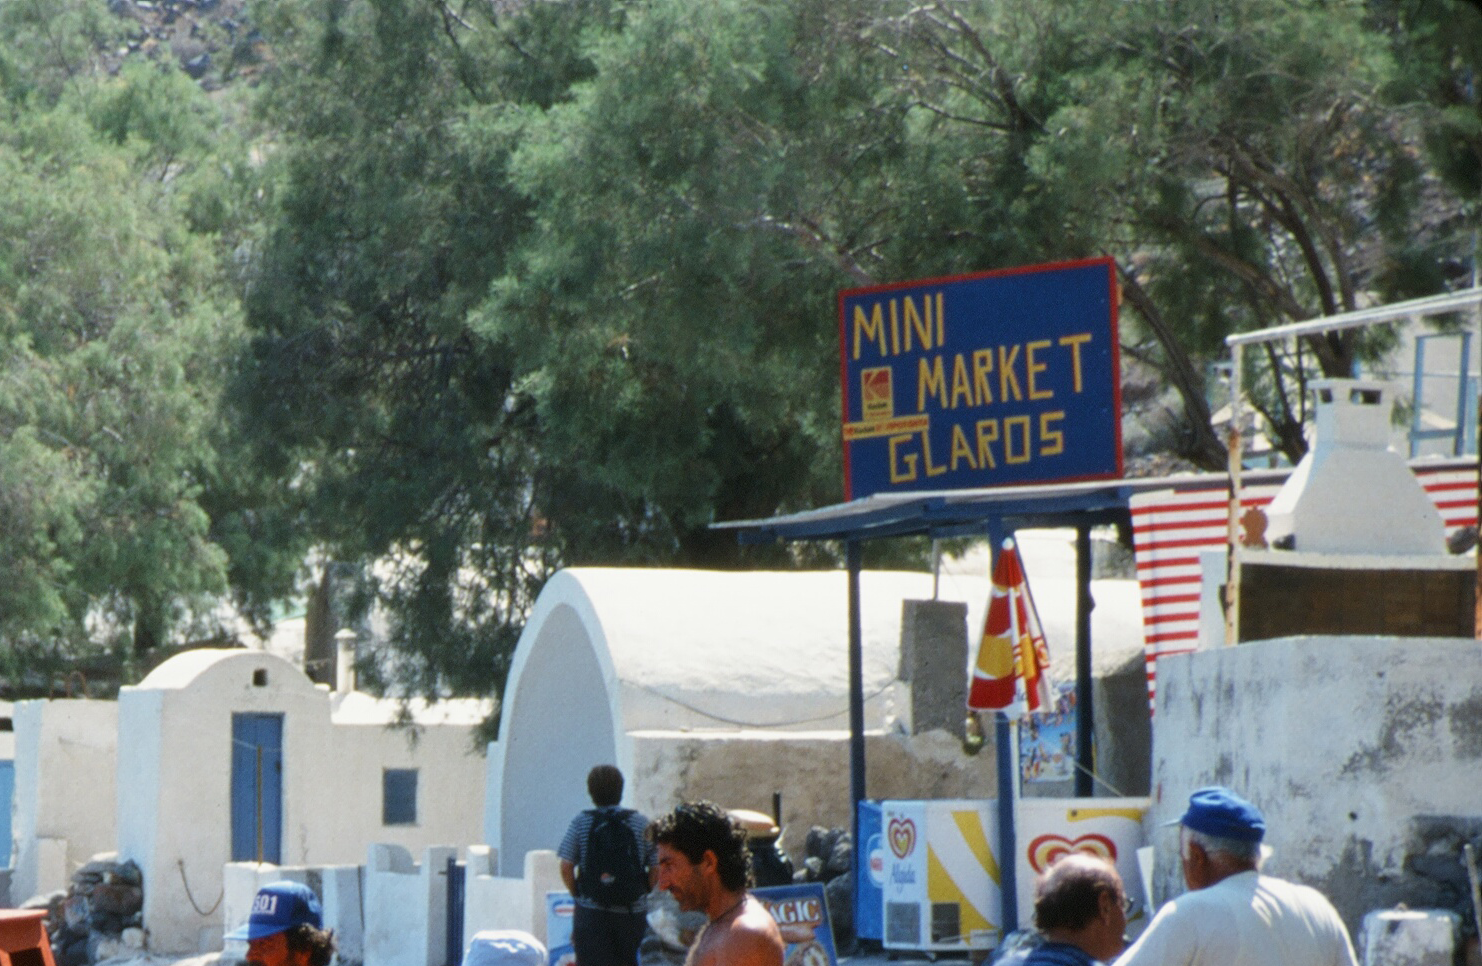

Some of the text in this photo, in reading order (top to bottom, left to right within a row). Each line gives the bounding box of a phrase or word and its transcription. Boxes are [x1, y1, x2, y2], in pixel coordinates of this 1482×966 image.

[852, 292, 944, 360] MINI
[917, 333, 1092, 412] MARKET
[889, 411, 1065, 483] GLAROS
[252, 894, 277, 915] 501
[769, 900, 820, 923] AGIC
